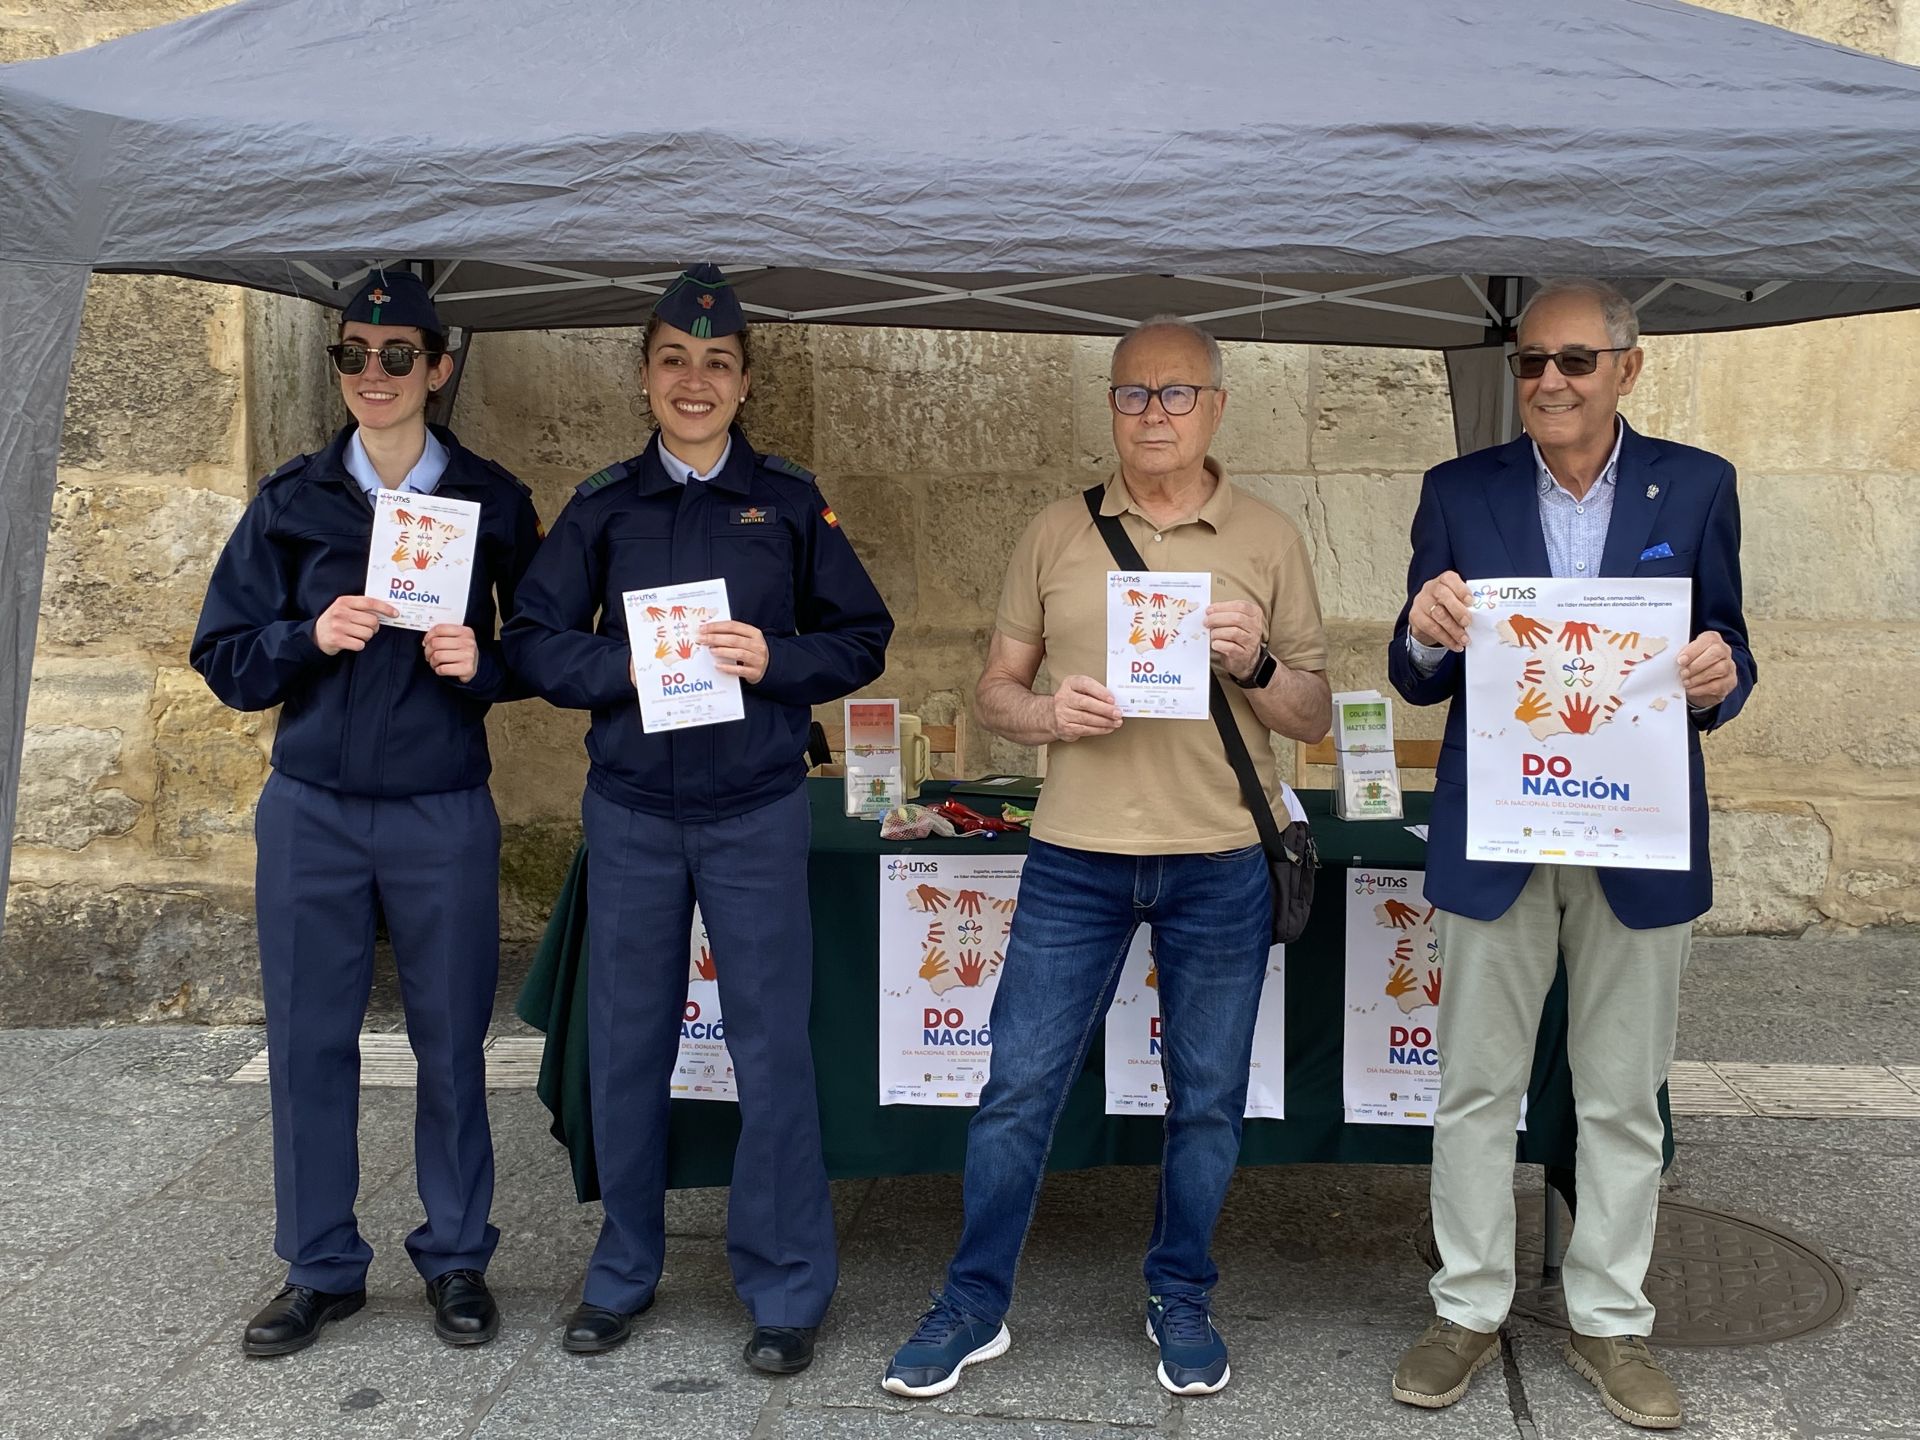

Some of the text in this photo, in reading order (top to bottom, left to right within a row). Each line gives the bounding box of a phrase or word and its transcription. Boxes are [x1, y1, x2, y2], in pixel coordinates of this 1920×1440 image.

[392, 495, 411, 503] UTxS
[391, 578, 415, 591] DO
[389, 590, 440, 604] NACIÓN
[639, 593, 657, 601] UTxS
[1499, 587, 1536, 600] UTxS
[1131, 661, 1155, 673] DO
[661, 672, 685, 686] DO
[1130, 671, 1181, 685] NACIÓN
[662, 679, 713, 696] NACIÓN
[1522, 753, 1572, 778] DO
[1522, 776, 1630, 802] NACIÓN
[1510, 800, 1551, 808] NACIONAL
[1569, 803, 1606, 811] DONANTE
[909, 862, 938, 873] UTxS
[1377, 876, 1408, 888] UTxS
[682, 1001, 700, 1022] O
[923, 1008, 964, 1029] DO
[680, 1019, 726, 1040] ACIÓ
[1150, 1017, 1162, 1038] D
[923, 1024, 993, 1047] NACIÓ
[1389, 1026, 1432, 1047] DO
[1389, 1048, 1438, 1066] NAC
